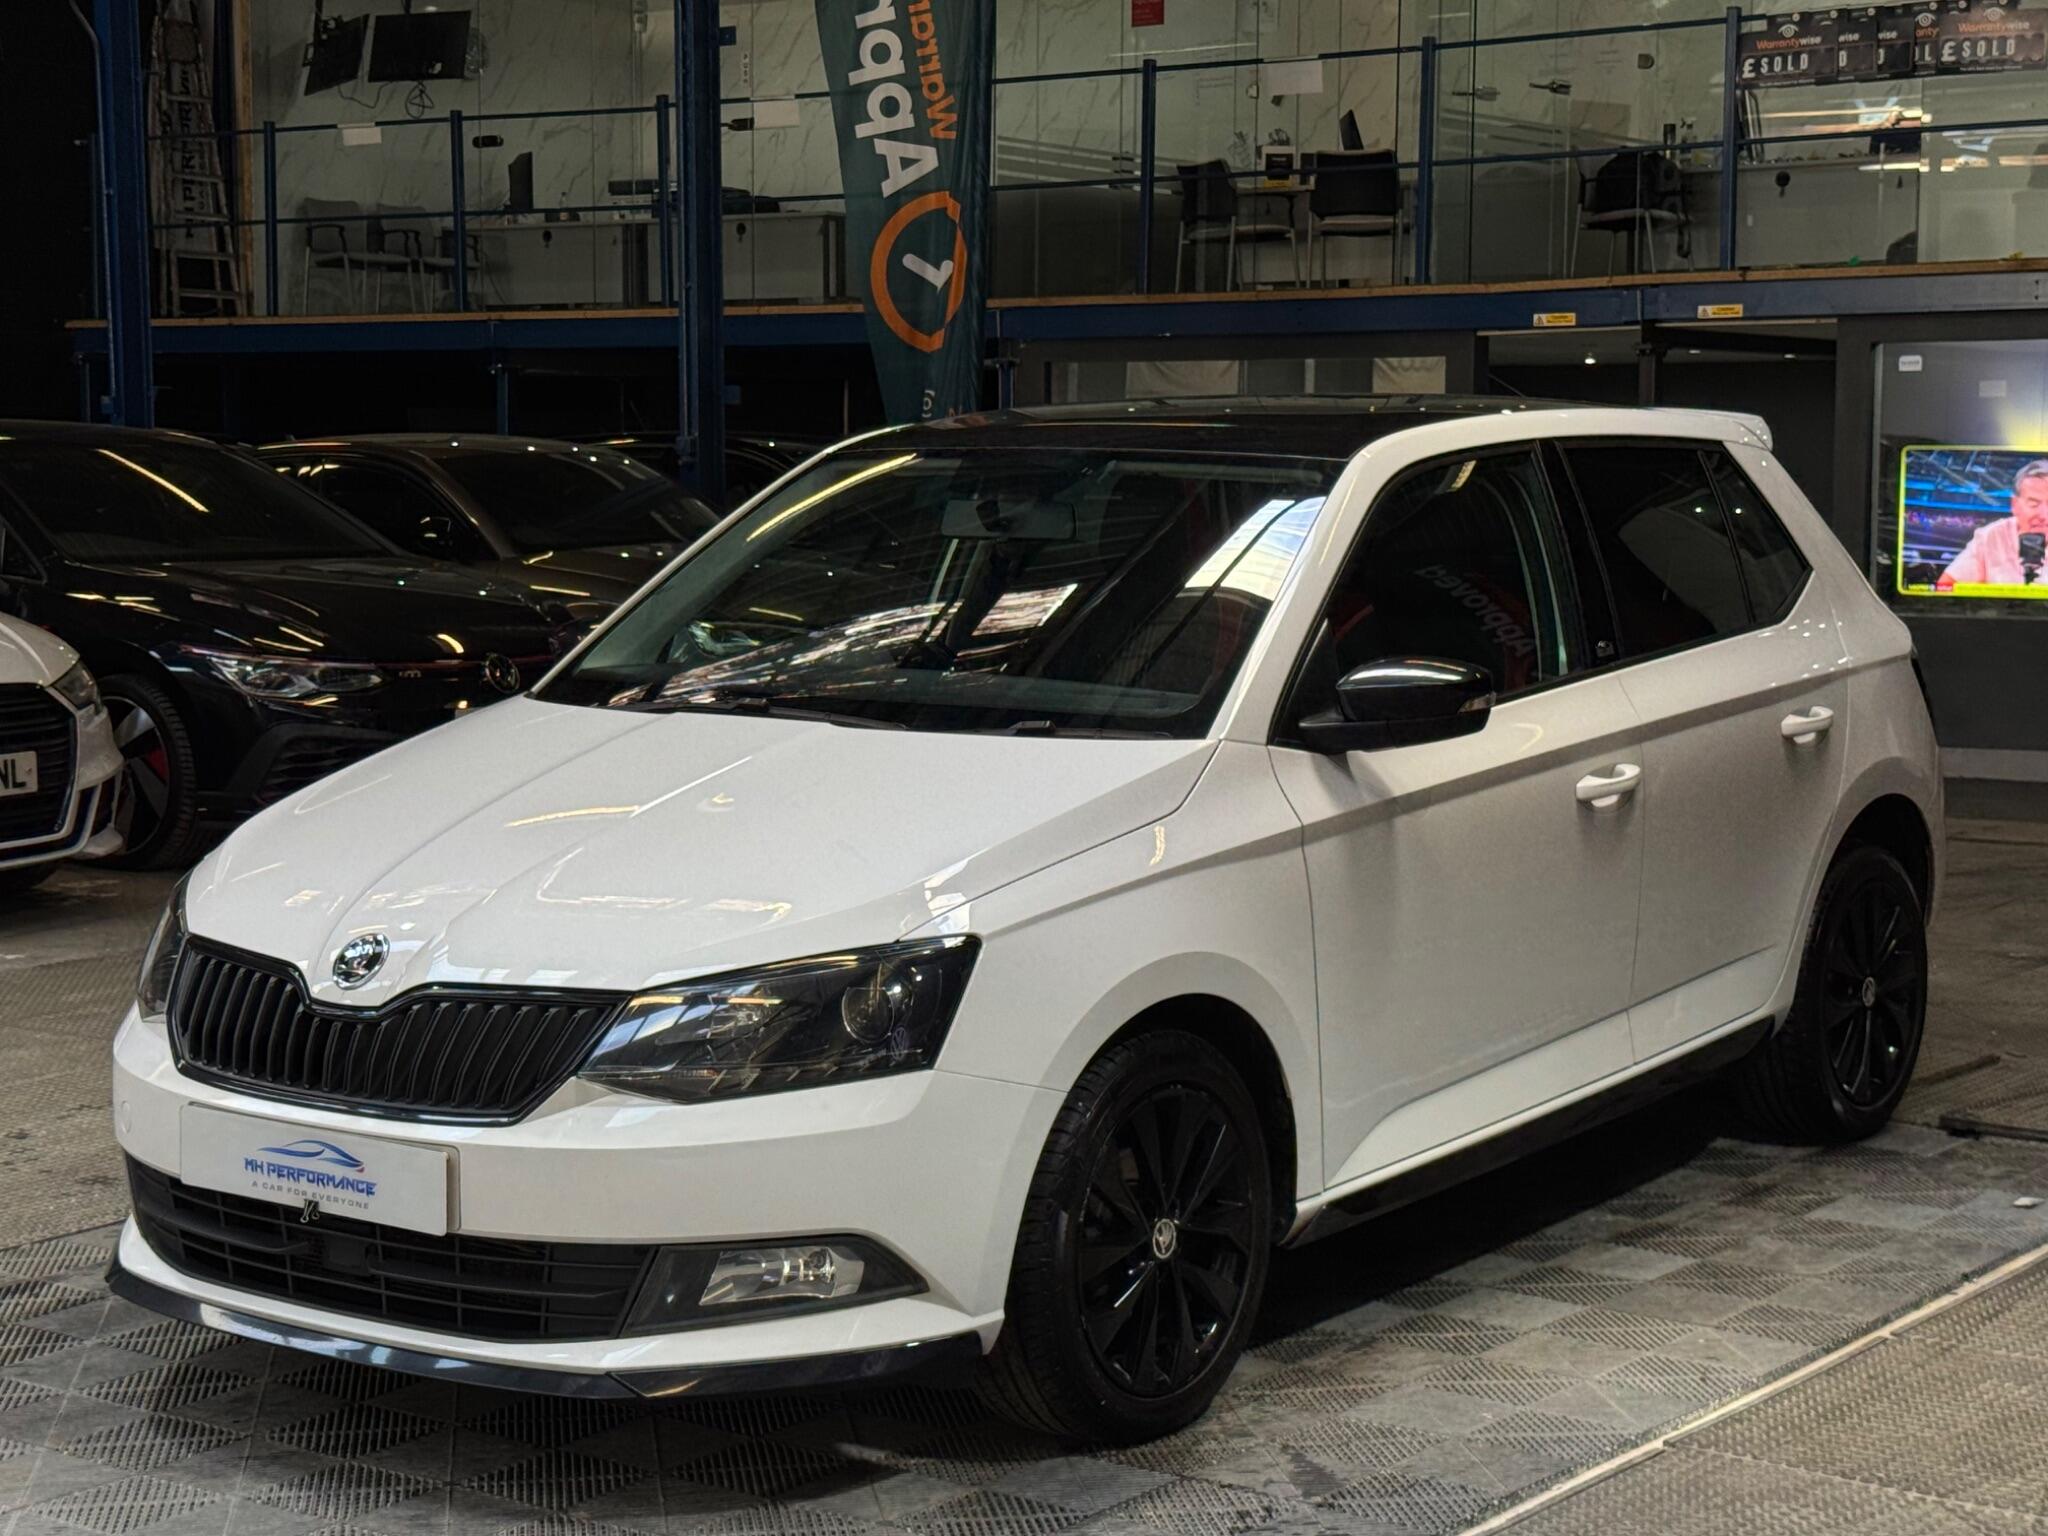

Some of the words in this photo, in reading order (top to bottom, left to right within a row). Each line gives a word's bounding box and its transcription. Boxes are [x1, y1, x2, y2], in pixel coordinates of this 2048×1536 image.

[1958, 21, 2030, 34] Warrantywise
[1756, 35, 1822, 50] Warrantywise
[244, 1158, 264, 1175] MH
[267, 1162, 377, 1196] PERFORMANCE
[251, 1180, 259, 1188] A
[262, 1182, 283, 1193] CAR
[287, 1186, 309, 1198] FOR
[311, 1191, 370, 1210] EVERYONE
